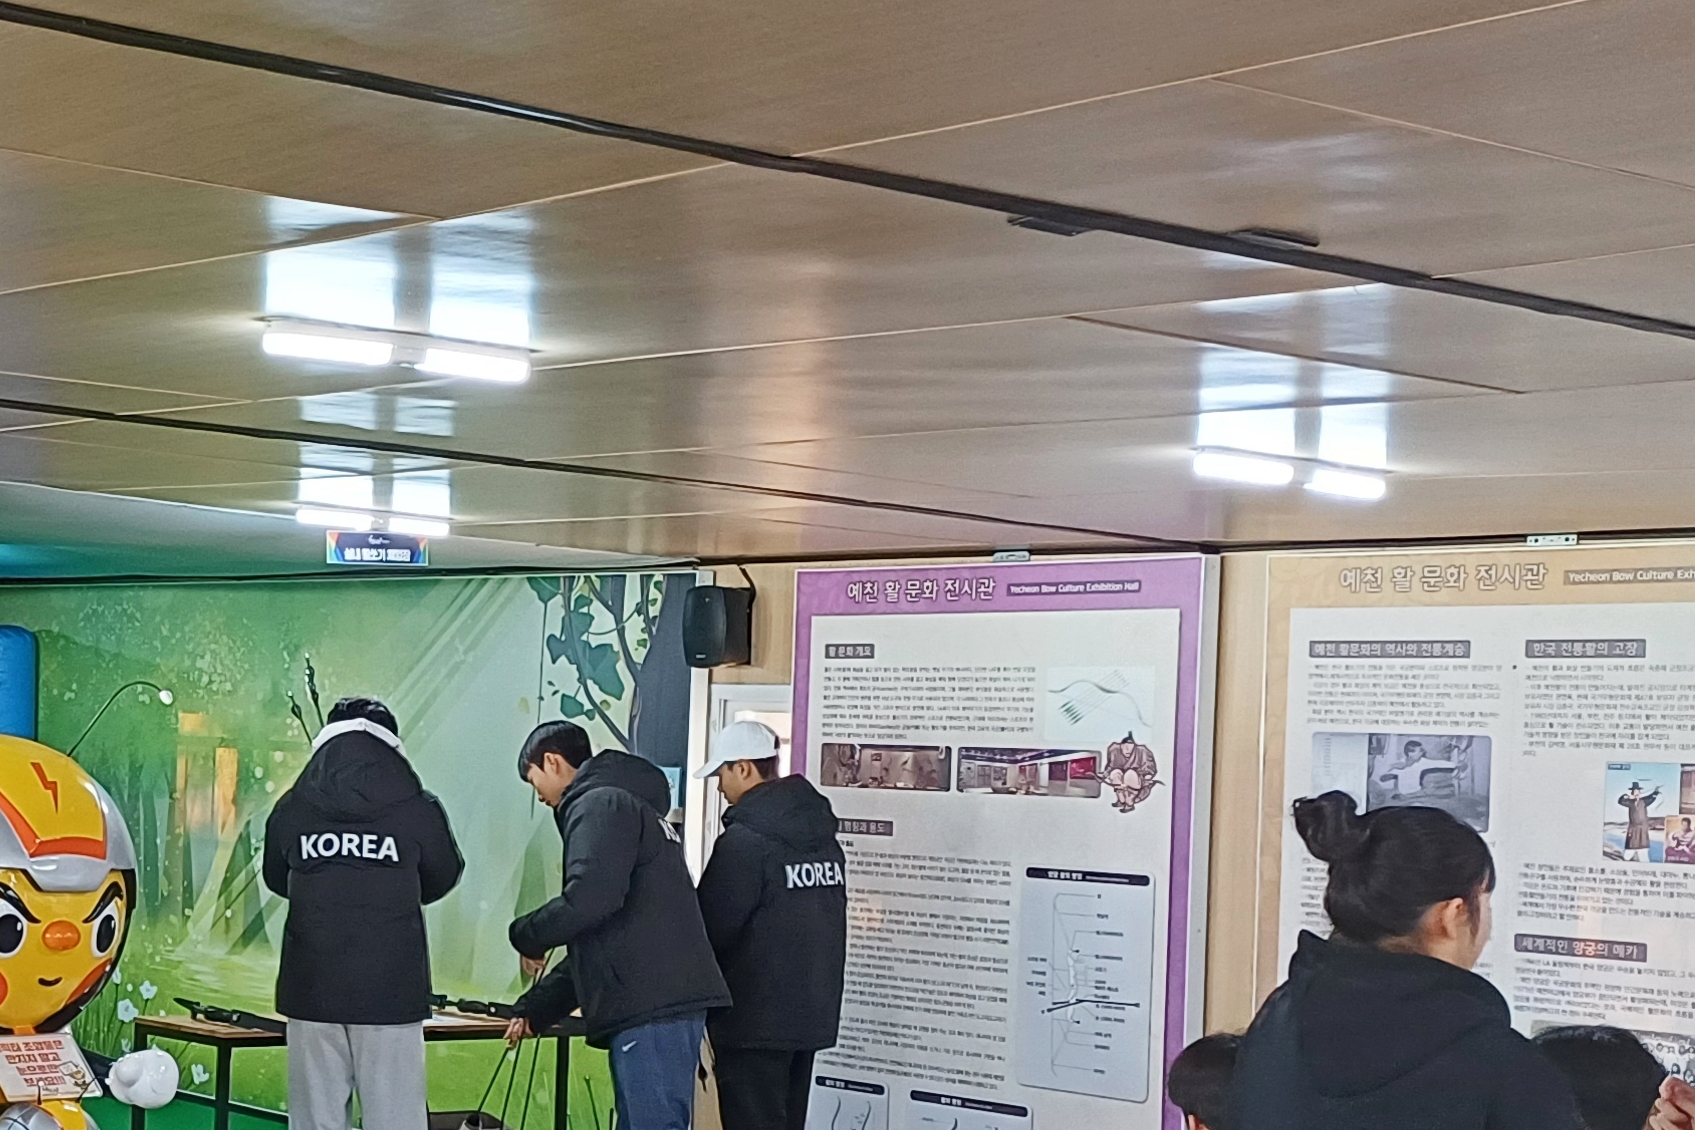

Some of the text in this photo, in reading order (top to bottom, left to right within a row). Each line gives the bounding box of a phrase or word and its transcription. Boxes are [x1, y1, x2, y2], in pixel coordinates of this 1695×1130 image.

[1058, 584, 1085, 592] Culture
[1086, 582, 1123, 592] Exhibition
[1339, 562, 1547, 594] 예천 활 문화 전시관
[1568, 571, 1610, 582] Yecheon
[1612, 571, 1635, 582] Bow
[1636, 569, 1674, 581] Culture
[846, 577, 996, 604] 예천 활 문화 전시관
[300, 832, 399, 862] KOREA
[785, 861, 844, 889] KOREA
[1521, 937, 1638, 960] 세계적인 양궁의 메카
